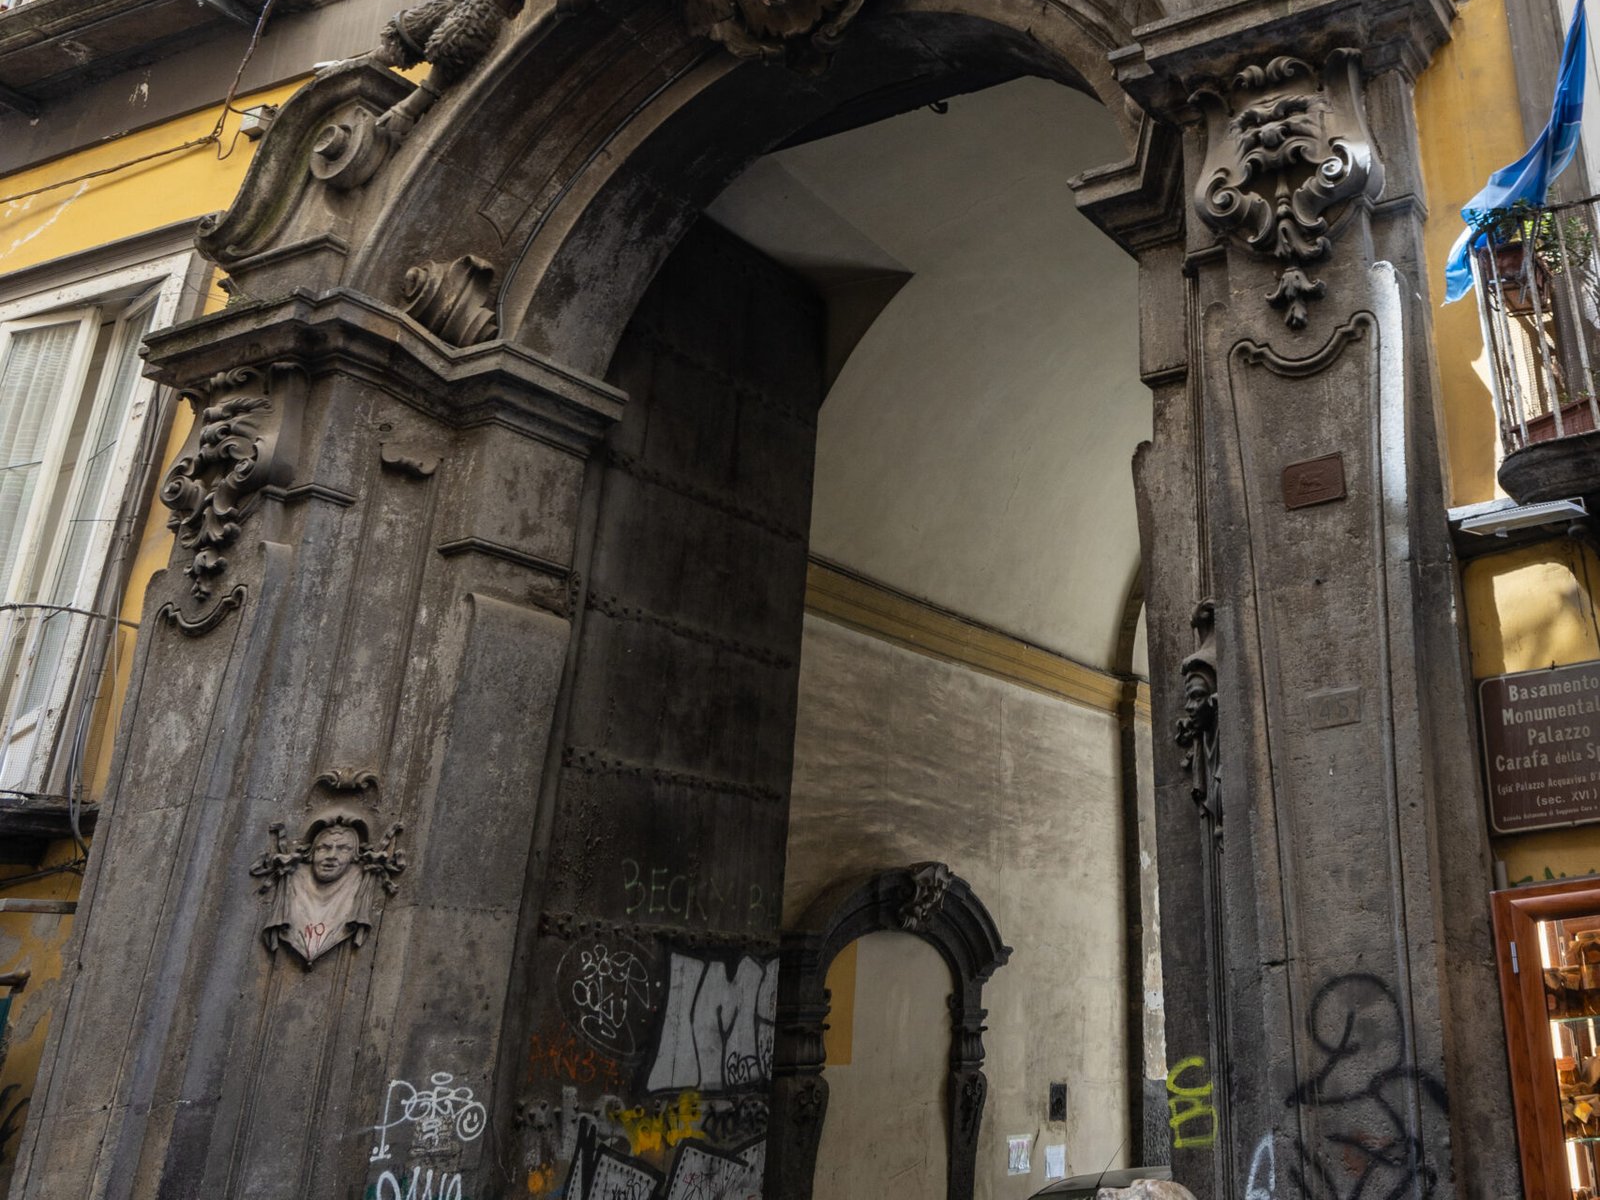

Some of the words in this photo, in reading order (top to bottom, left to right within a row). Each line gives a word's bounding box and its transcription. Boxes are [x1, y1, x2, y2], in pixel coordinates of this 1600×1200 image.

[1508, 675, 1599, 702] Basamento
[1527, 725, 1590, 746] Palazzo
[1495, 749, 1549, 772] Carafa
[1555, 750, 1582, 764] della
[1515, 781, 1545, 792] Palazzo
[1548, 774, 1586, 788] Acquaviva
[1536, 795, 1566, 807] (sec.
